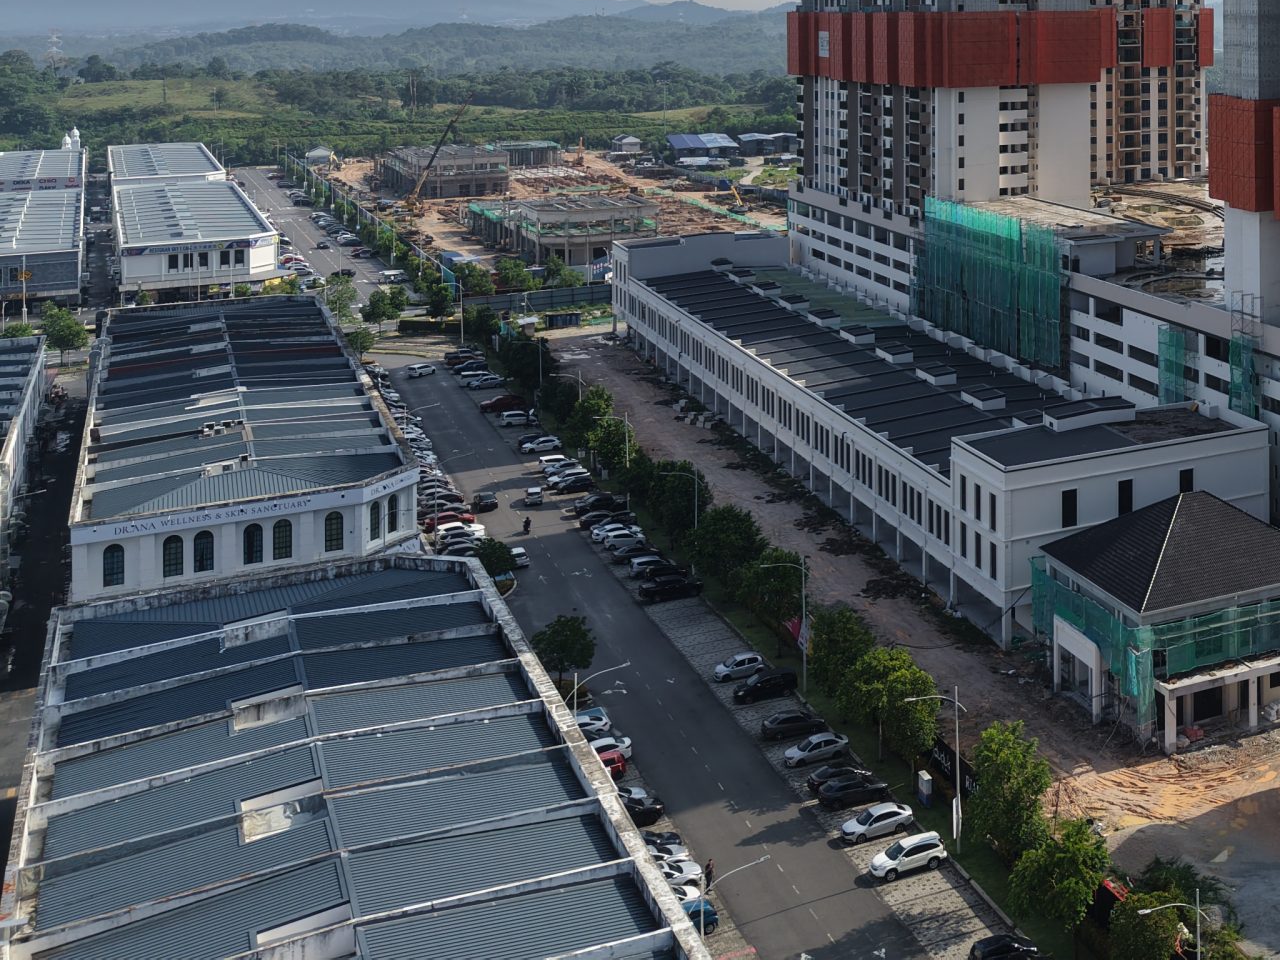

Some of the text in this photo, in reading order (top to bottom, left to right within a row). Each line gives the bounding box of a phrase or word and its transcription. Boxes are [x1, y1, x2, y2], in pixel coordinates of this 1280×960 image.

[161, 514, 211, 527] WELLNESS
[226, 508, 248, 519] SKIN
[251, 500, 307, 514] SANCTUARY
